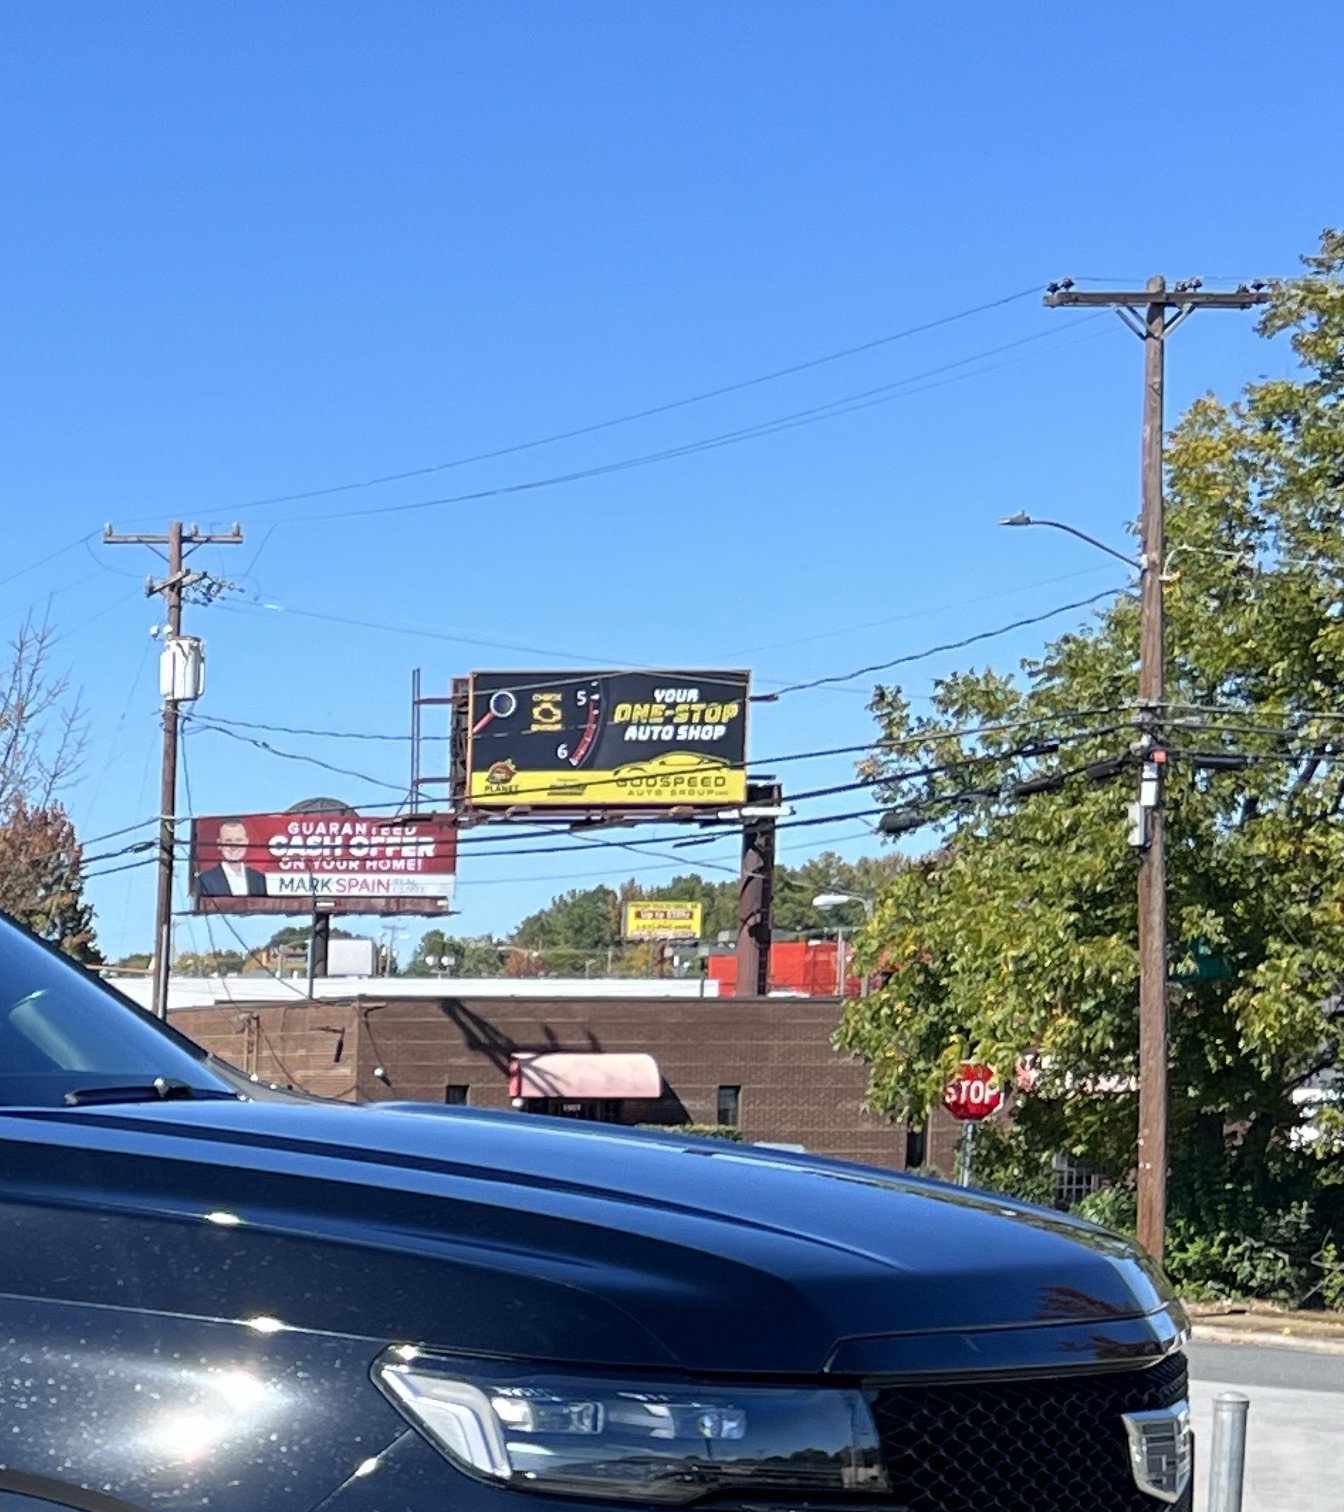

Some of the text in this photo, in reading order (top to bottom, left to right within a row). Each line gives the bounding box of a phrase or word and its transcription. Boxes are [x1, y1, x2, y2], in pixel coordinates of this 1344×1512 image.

[576, 690, 587, 706] 5
[654, 689, 699, 702] YOUR
[614, 703, 739, 723] ONE-STOP
[624, 725, 727, 741] AUTO SHOP
[557, 743, 568, 759] 6
[616, 776, 726, 787] GODSPEED
[268, 835, 436, 857] CASH OFFER
[279, 858, 423, 871] ON YOUR HOME!
[278, 877, 390, 894] MARK SPAIN
[945, 1080, 1000, 1104] STOP
